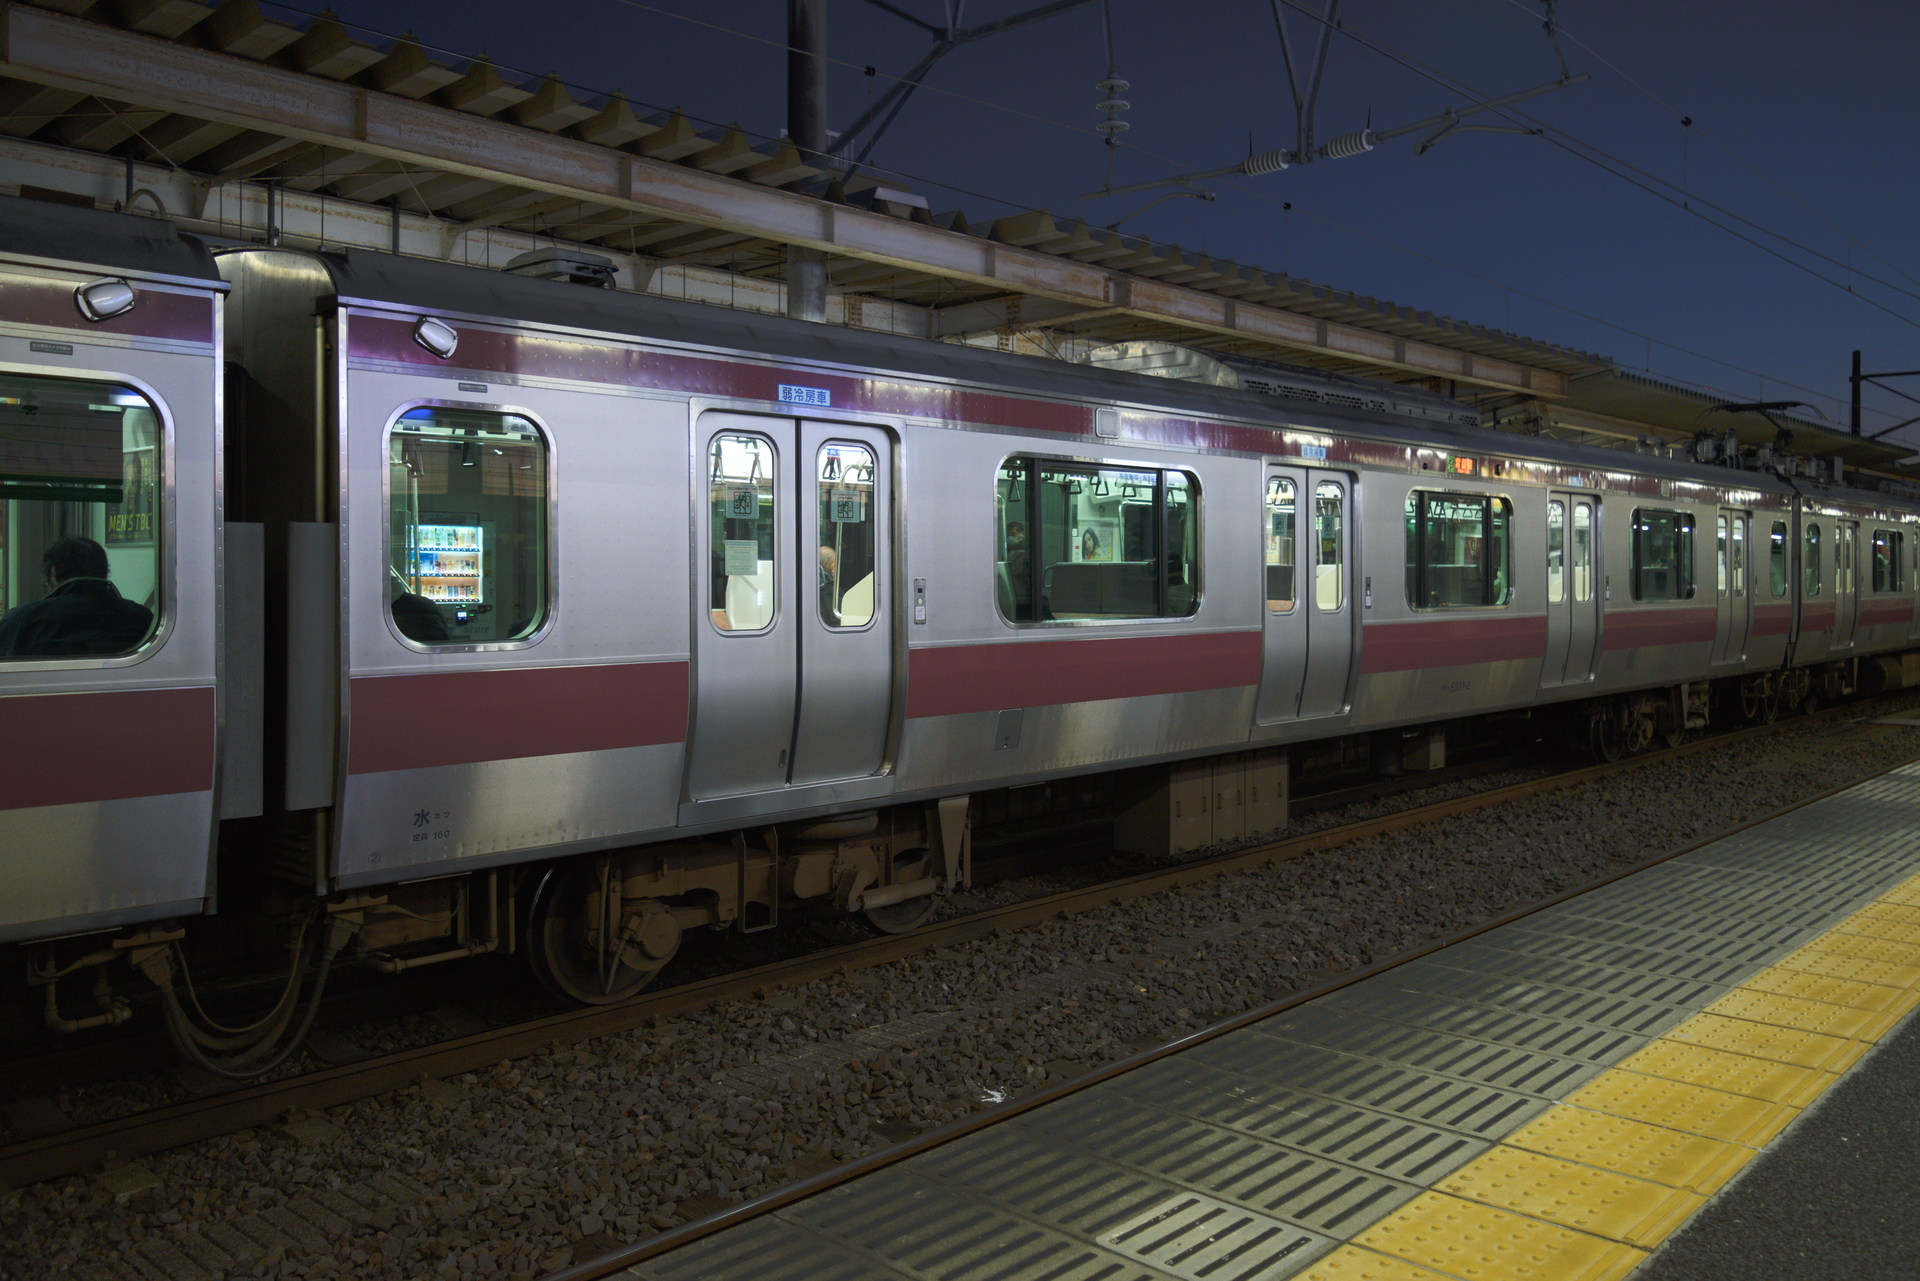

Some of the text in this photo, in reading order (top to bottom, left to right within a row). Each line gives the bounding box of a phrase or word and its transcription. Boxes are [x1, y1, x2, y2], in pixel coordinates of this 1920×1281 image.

[782, 386, 827, 404] 弱冷房車
[109, 512, 153, 532] MEN'S TBC
[413, 809, 430, 828] 水
[412, 830, 450, 842] 定員 160
